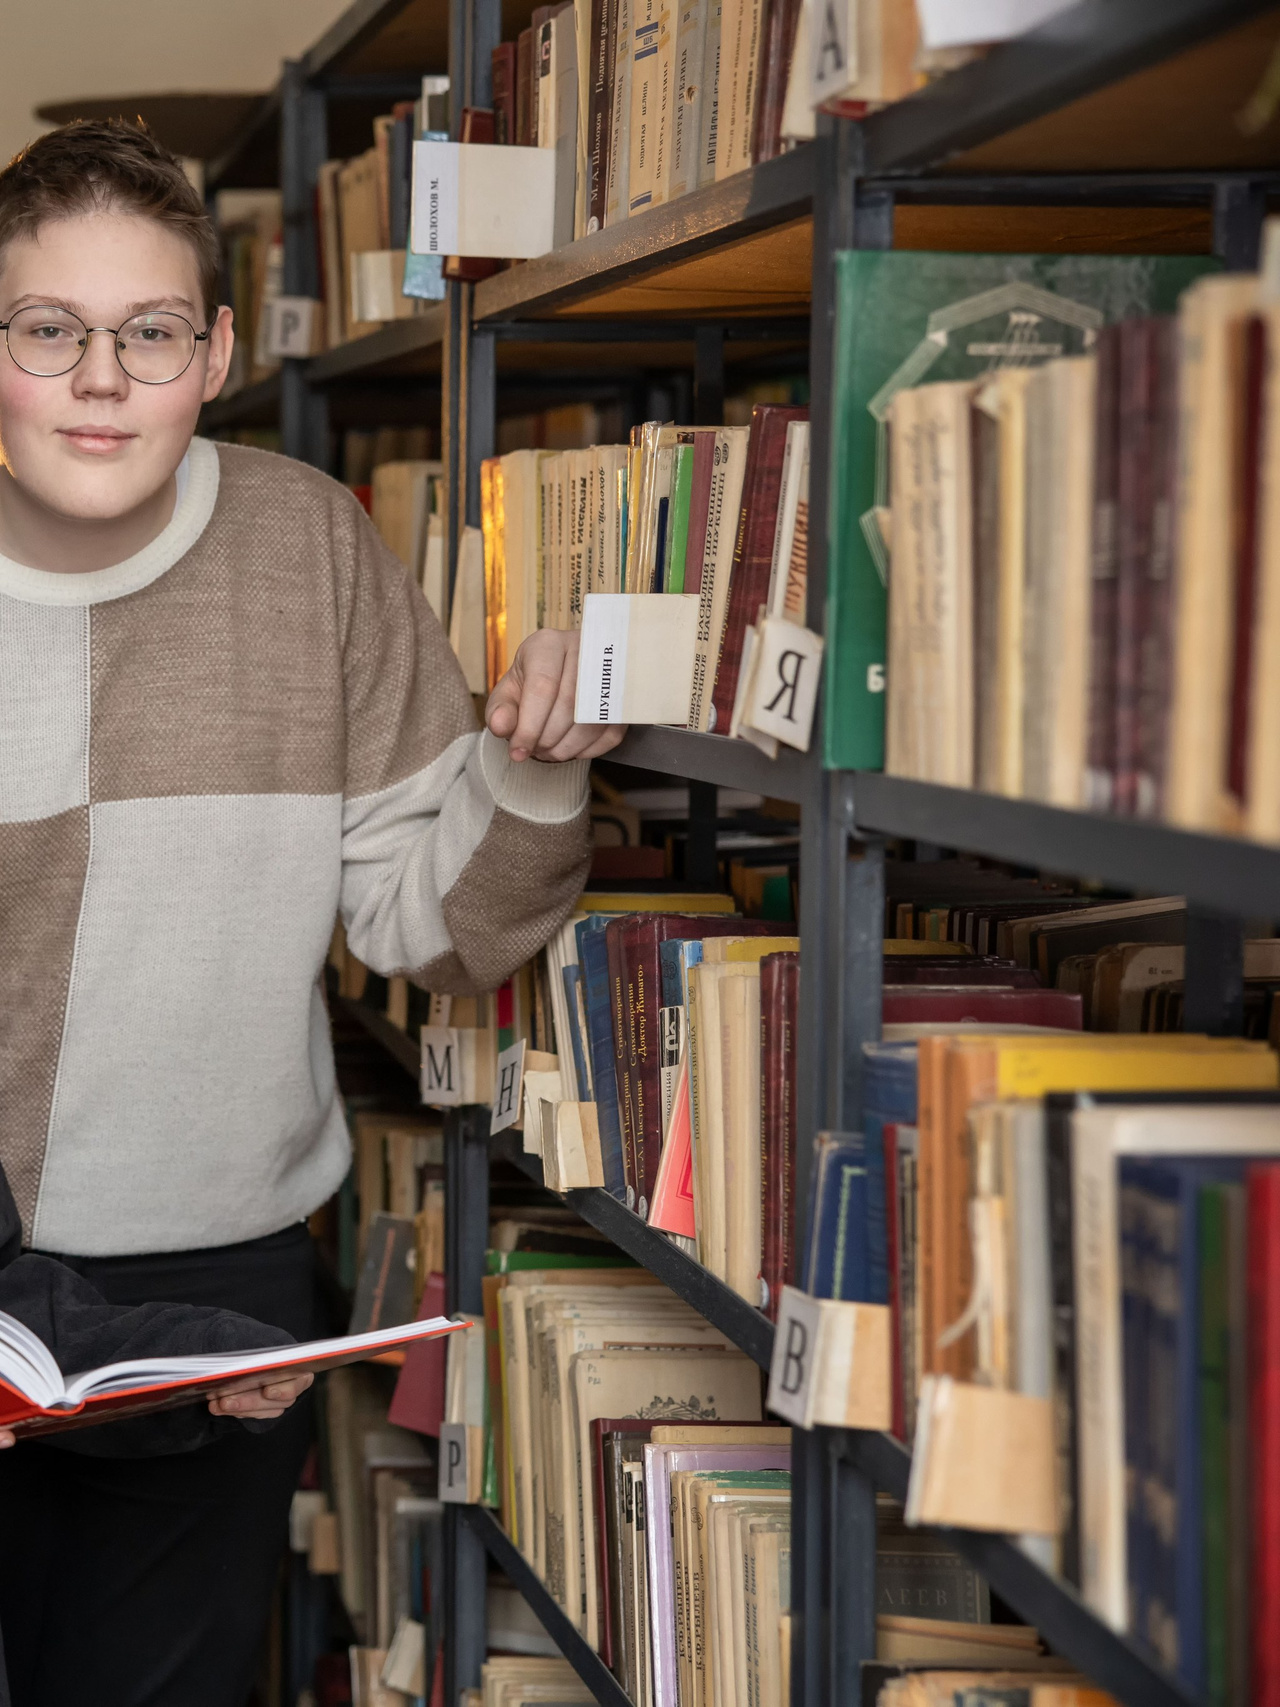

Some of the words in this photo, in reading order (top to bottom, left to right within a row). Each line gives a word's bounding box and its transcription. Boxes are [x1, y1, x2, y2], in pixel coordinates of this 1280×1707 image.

[595, 38, 606, 93] Поднятая
[817, 1, 843, 81] А
[678, 49, 687, 100] ЦЕЛИНА
[593, 112, 602, 165] Шолохов
[610, 128, 619, 188] ПОДНЯТАЯ
[615, 75, 624, 123] ЦЕЛИНА
[656, 116, 665, 179] ПОДНЯТАЯ
[675, 105, 684, 170] ПОДНЯТАЯ
[707, 100, 718, 165] ПОДНЯТАЯ
[430, 178, 439, 190] М.
[591, 183, 599, 200] М.
[592, 168, 599, 181] А.
[429, 192, 439, 251] ШОЛОХОВ
[578, 476, 587, 544] РАССКАЗЫ
[598, 466, 606, 525] Шолохов
[597, 528, 605, 585] Михаил
[696, 562, 710, 641] ВАСИЛИЙ
[705, 473, 718, 558] ШУКШИН
[703, 562, 716, 642] ВАСИЛИЙ
[712, 472, 725, 557] ШУКШИН
[733, 507, 747, 562] Повести
[604, 643, 614, 656] В.
[599, 657, 613, 721] ШУКШИН
[763, 650, 807, 723] Я
[616, 976, 624, 1059] Стихотворения
[636, 964, 647, 1014] Живаго»
[627, 983, 637, 1067] Стихотворения
[638, 1015, 647, 1063] «Доктор
[426, 1043, 454, 1091] М
[496, 1060, 518, 1118] Н
[622, 1071, 631, 1132] Пастернак
[636, 1079, 644, 1142] Пастернак
[780, 1318, 809, 1396] В
[447, 1441, 460, 1488] Р
[676, 1560, 685, 1658] К.Ф.РЫЛЕЕВ
[693, 1572, 702, 1671] К.Ф.РЫЛЕЕВ
[883, 1588, 948, 1606] ЛЕЕВ
